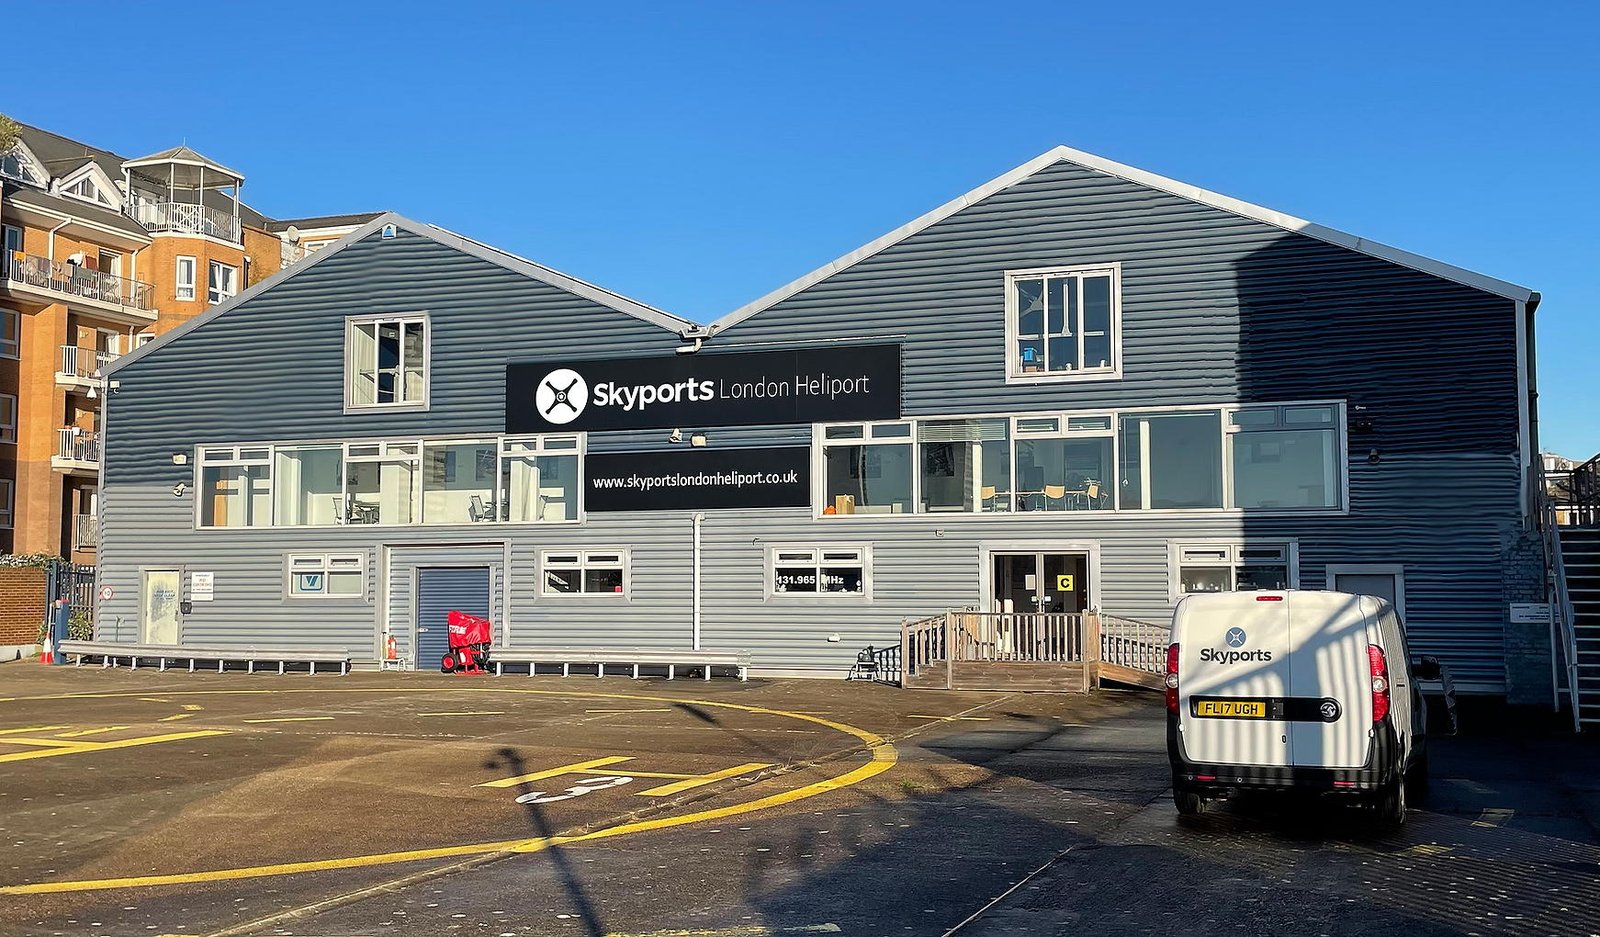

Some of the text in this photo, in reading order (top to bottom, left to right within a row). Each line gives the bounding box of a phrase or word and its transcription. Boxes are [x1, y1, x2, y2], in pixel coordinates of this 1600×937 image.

[592, 372, 870, 411] Skyports London Heliport
[592, 469, 798, 492] www.skyportslondonheliport.co.uk
[777, 575, 815, 585] 131.965
[1060, 578, 1070, 588] C
[1200, 648, 1272, 664] Skyports
[1205, 704, 1258, 715] FL17 UGH
